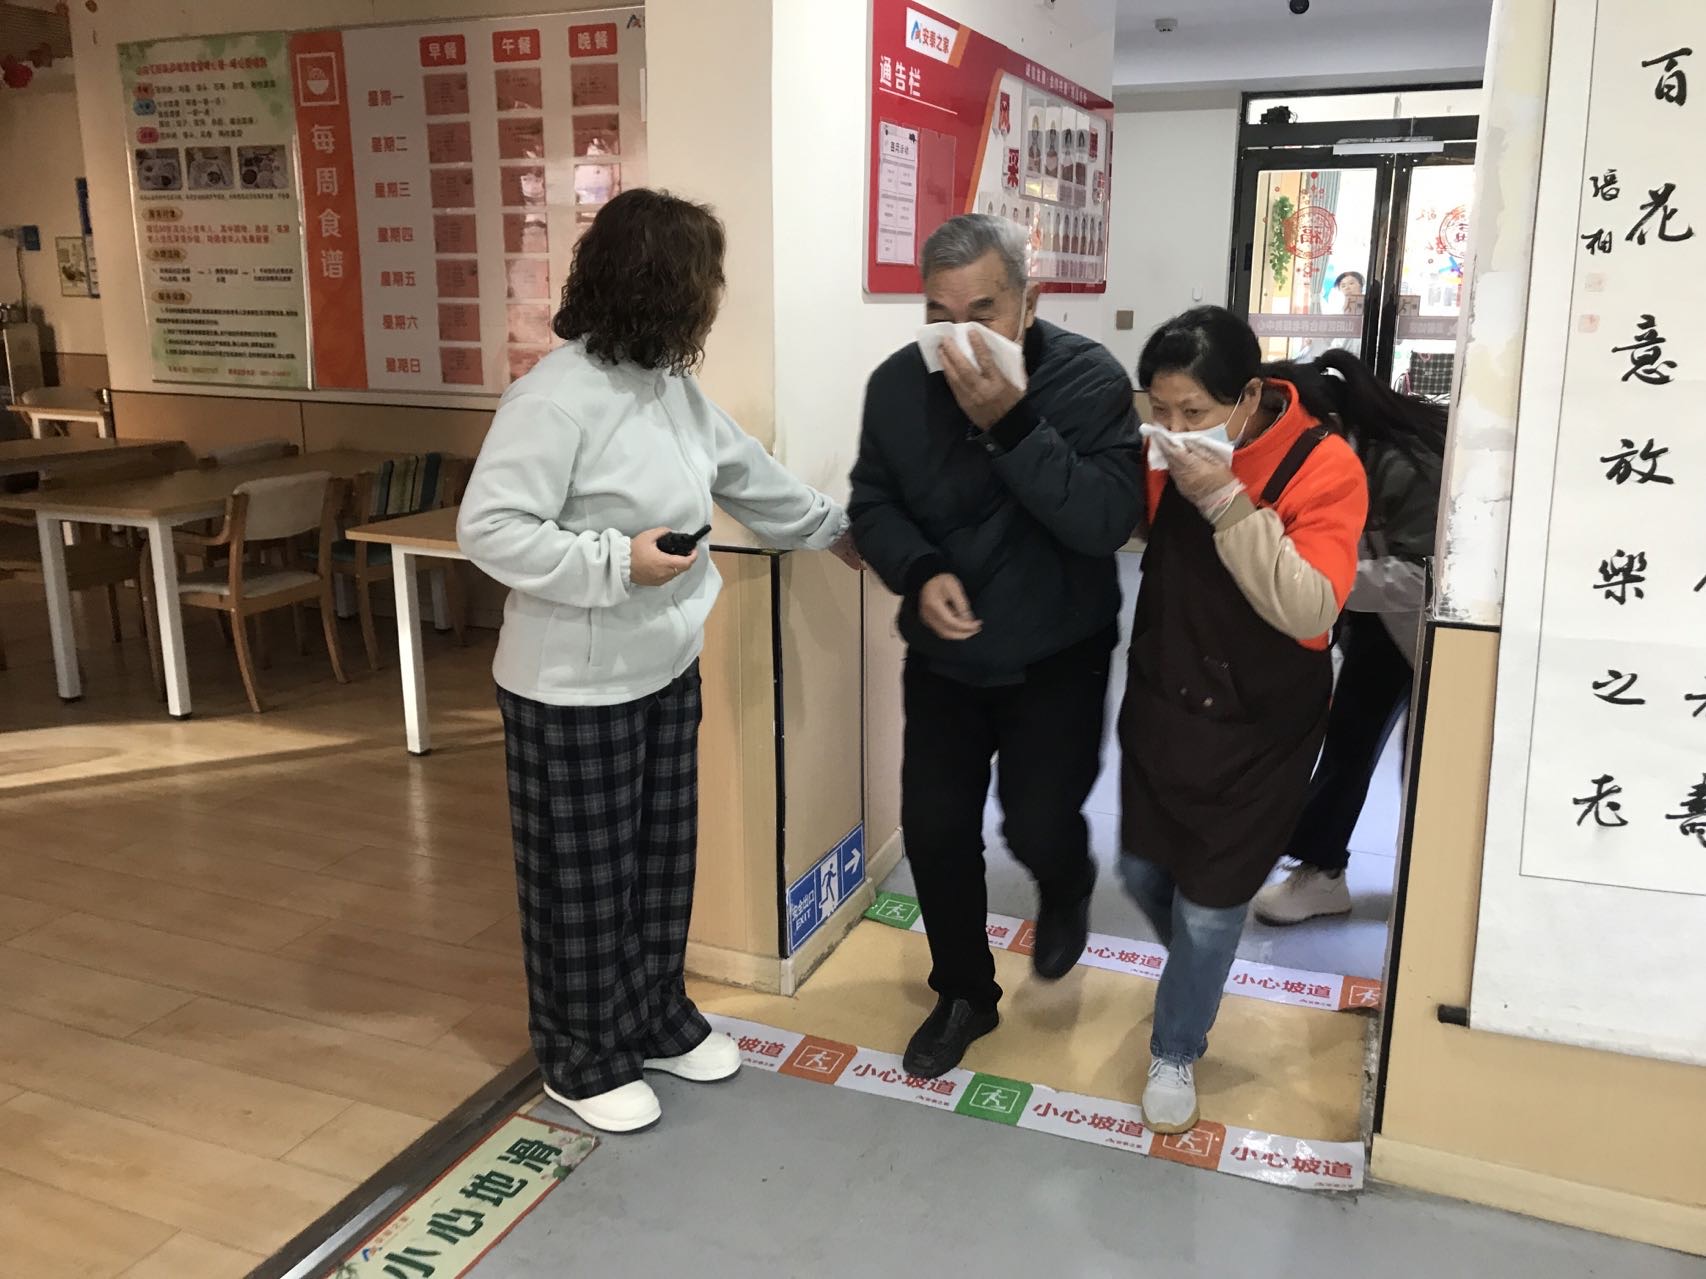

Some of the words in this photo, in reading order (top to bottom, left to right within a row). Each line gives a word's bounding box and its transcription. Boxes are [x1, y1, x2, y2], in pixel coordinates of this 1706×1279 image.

[500, 35, 532, 56] 午餐
[577, 29, 609, 50] 晚餐
[427, 41, 458, 61] 早餐
[880, 54, 921, 97] 通告栏
[368, 89, 404, 107] 星期一
[371, 136, 408, 153] 星期二
[374, 181, 411, 199] 星期三
[311, 123, 345, 280] 每周食谱
[377, 226, 414, 244] 星期四
[380, 271, 416, 288] 星期五
[382, 313, 418, 331] 星期六
[385, 356, 422, 374] 星期日
[795, 908, 812, 931] EXIT
[1087, 945, 1163, 970] 心坡道
[1233, 973, 1332, 999] 小心坡道
[1032, 1102, 1148, 1138] 小心坡道
[1230, 1146, 1353, 1179] 小心坡道
[383, 1137, 563, 1279] 小心地滑
